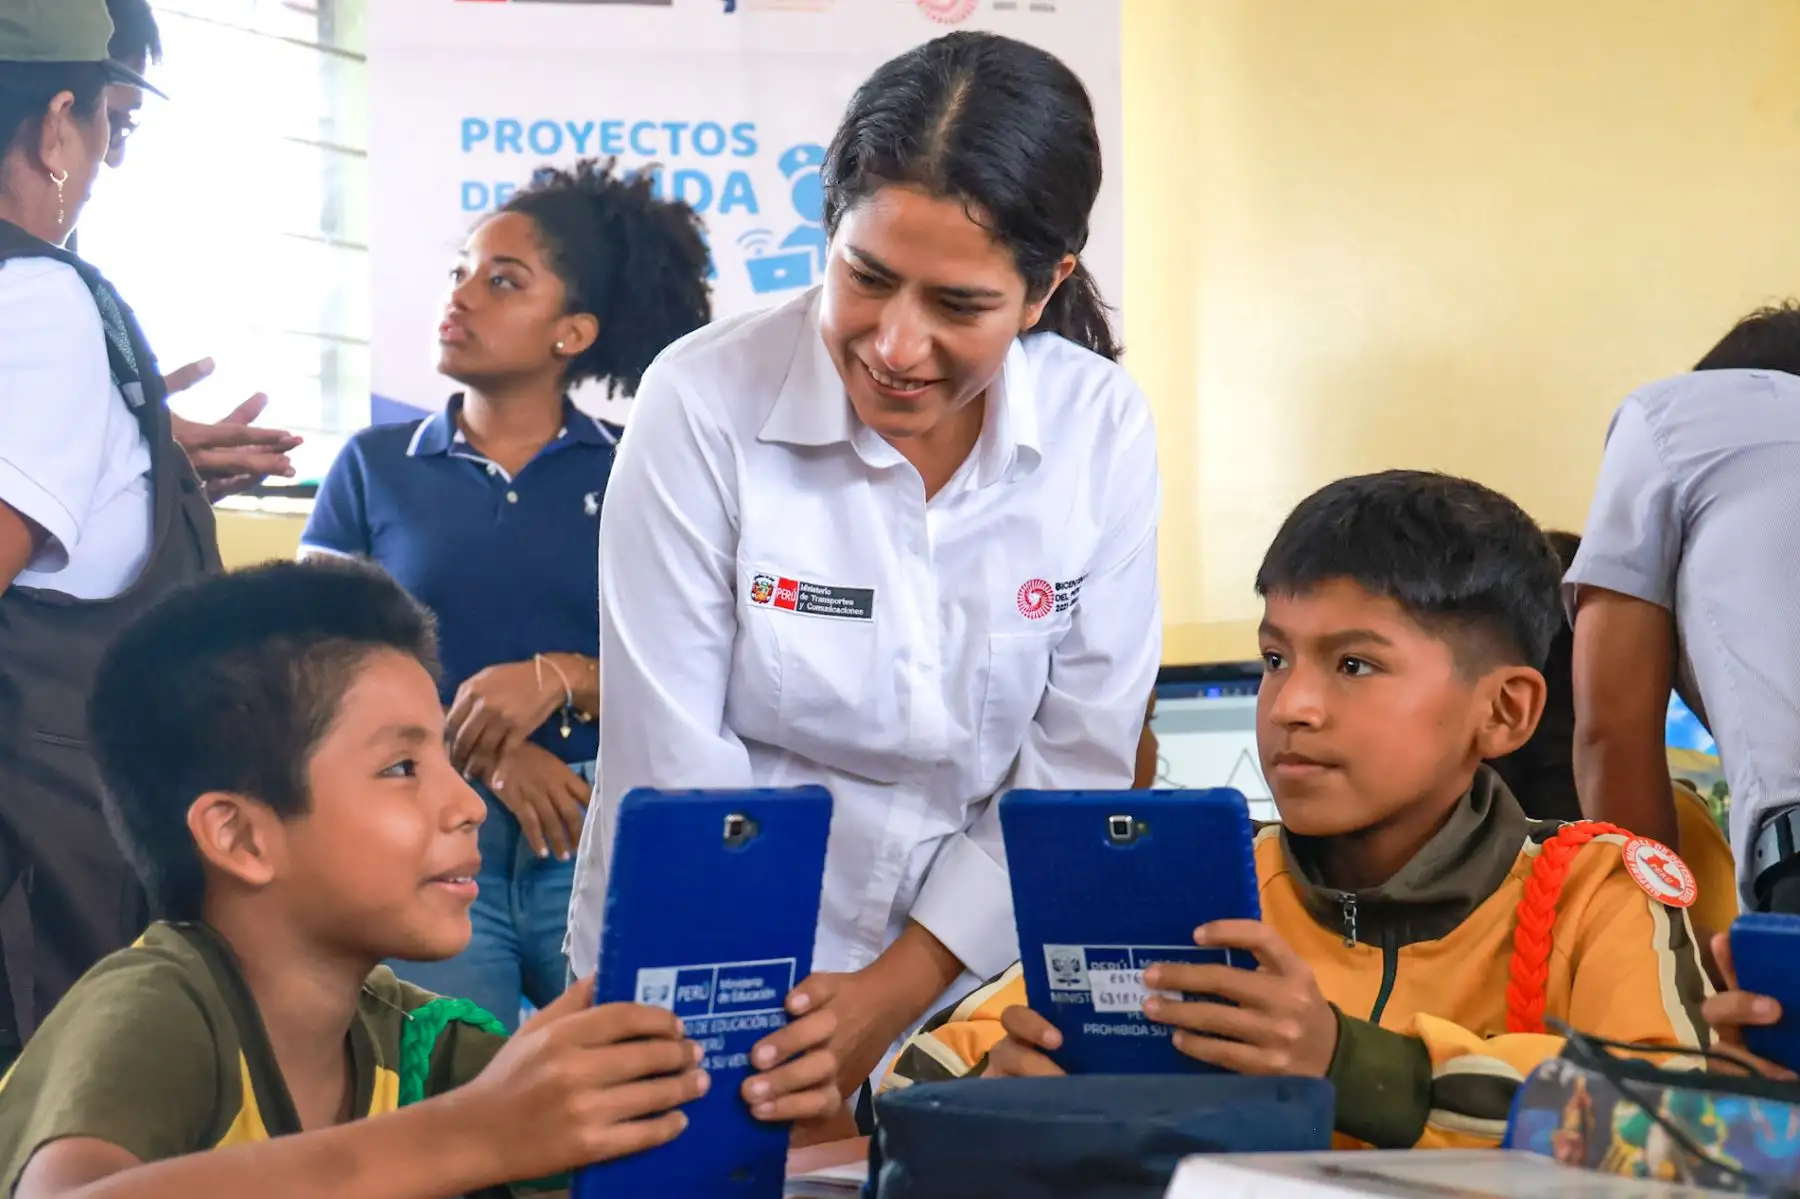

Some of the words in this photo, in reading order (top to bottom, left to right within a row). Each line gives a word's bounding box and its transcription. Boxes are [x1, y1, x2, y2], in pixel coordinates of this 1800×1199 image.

[461, 118, 757, 156] PROYECTOS
[777, 587, 797, 602] PERÚ
[801, 584, 831, 596] Ministerio
[800, 593, 808, 601] de
[812, 595, 854, 607] Transportes
[807, 603, 864, 616] Comunicaciones
[677, 980, 711, 1002] PERÚ
[1051, 993, 1092, 1004] MINIST
[711, 1016, 769, 1033] EDUCACIÓN
[1083, 1023, 1148, 1036] PROHIBIDA
[1150, 1024, 1167, 1036] SU
